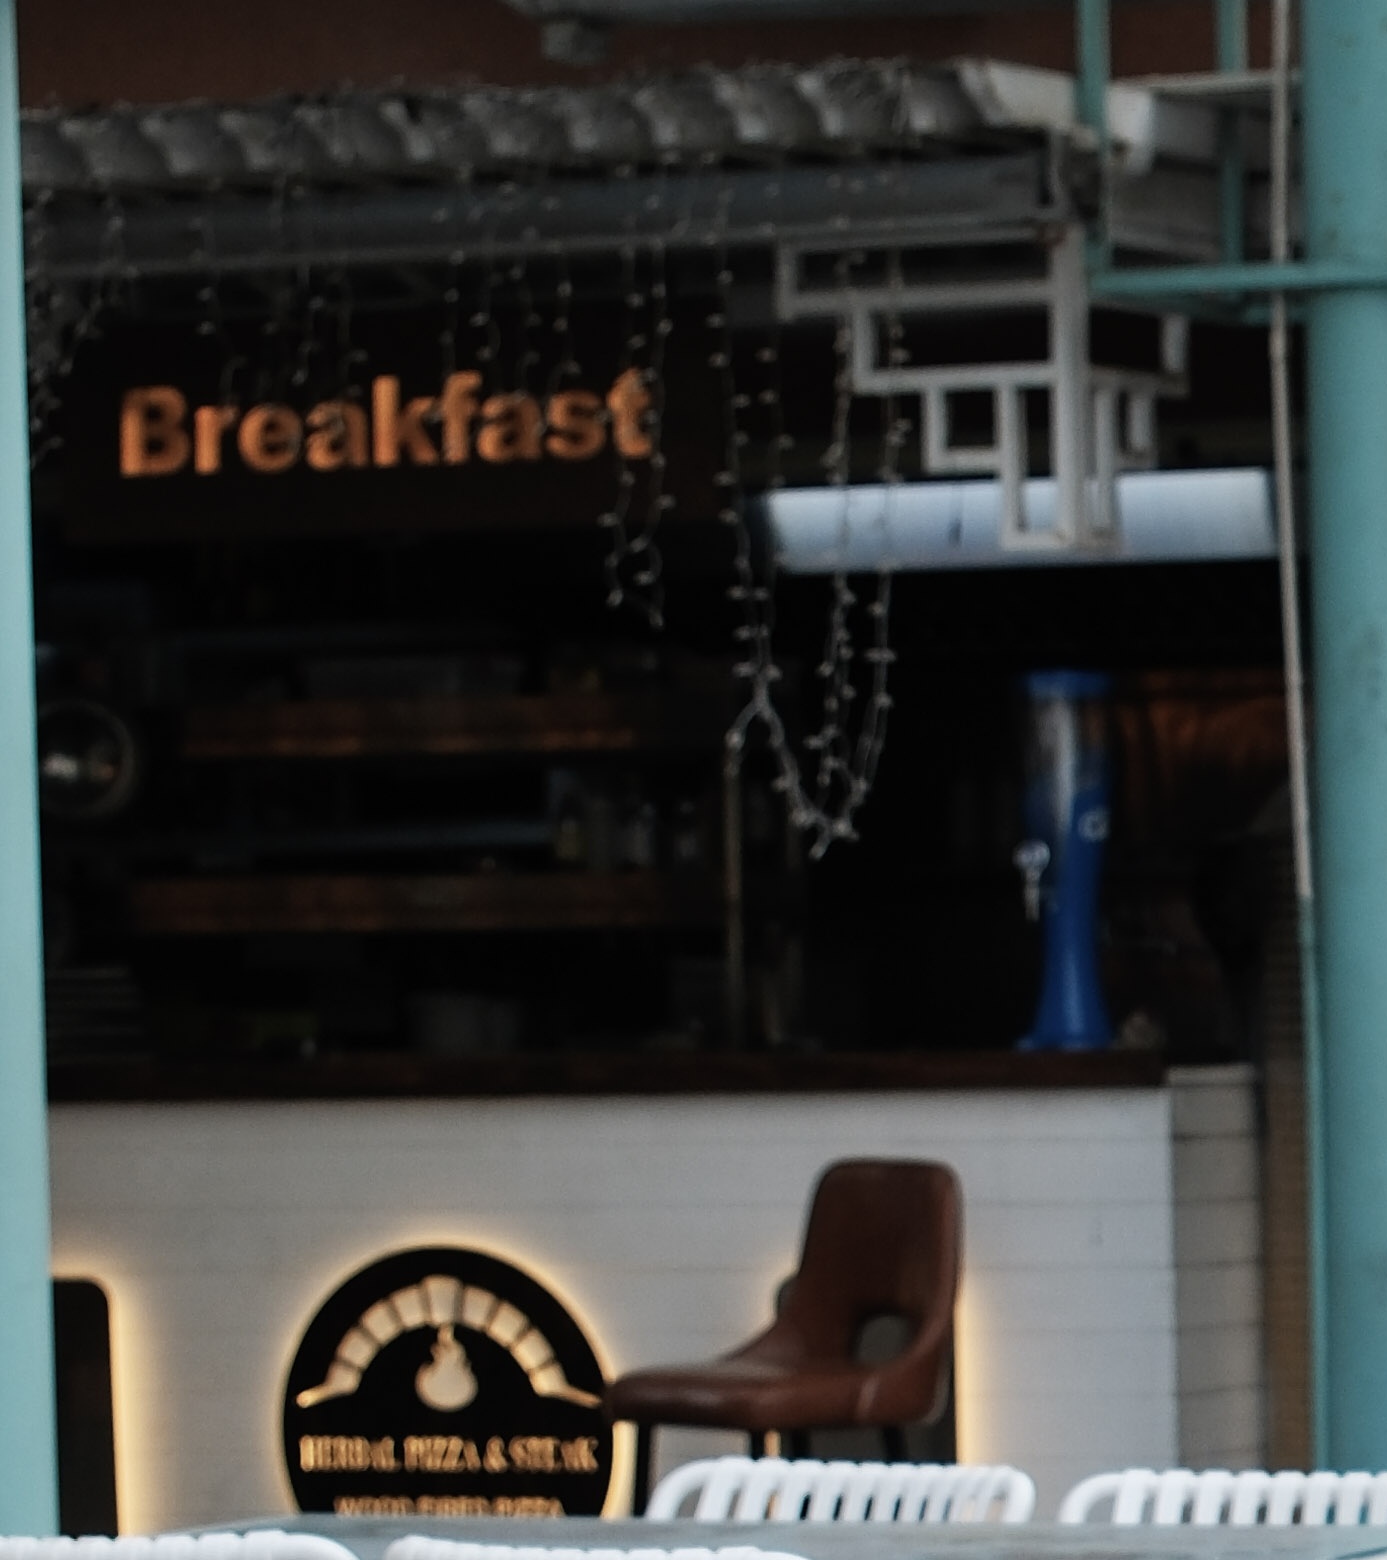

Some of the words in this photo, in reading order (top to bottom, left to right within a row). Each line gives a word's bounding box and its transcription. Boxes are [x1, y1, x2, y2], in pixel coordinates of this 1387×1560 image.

[119, 367, 658, 479] Breakfast
[403, 1434, 482, 1473] PIZZA
[483, 1434, 508, 1473] &
[508, 1434, 600, 1473] STEAK
